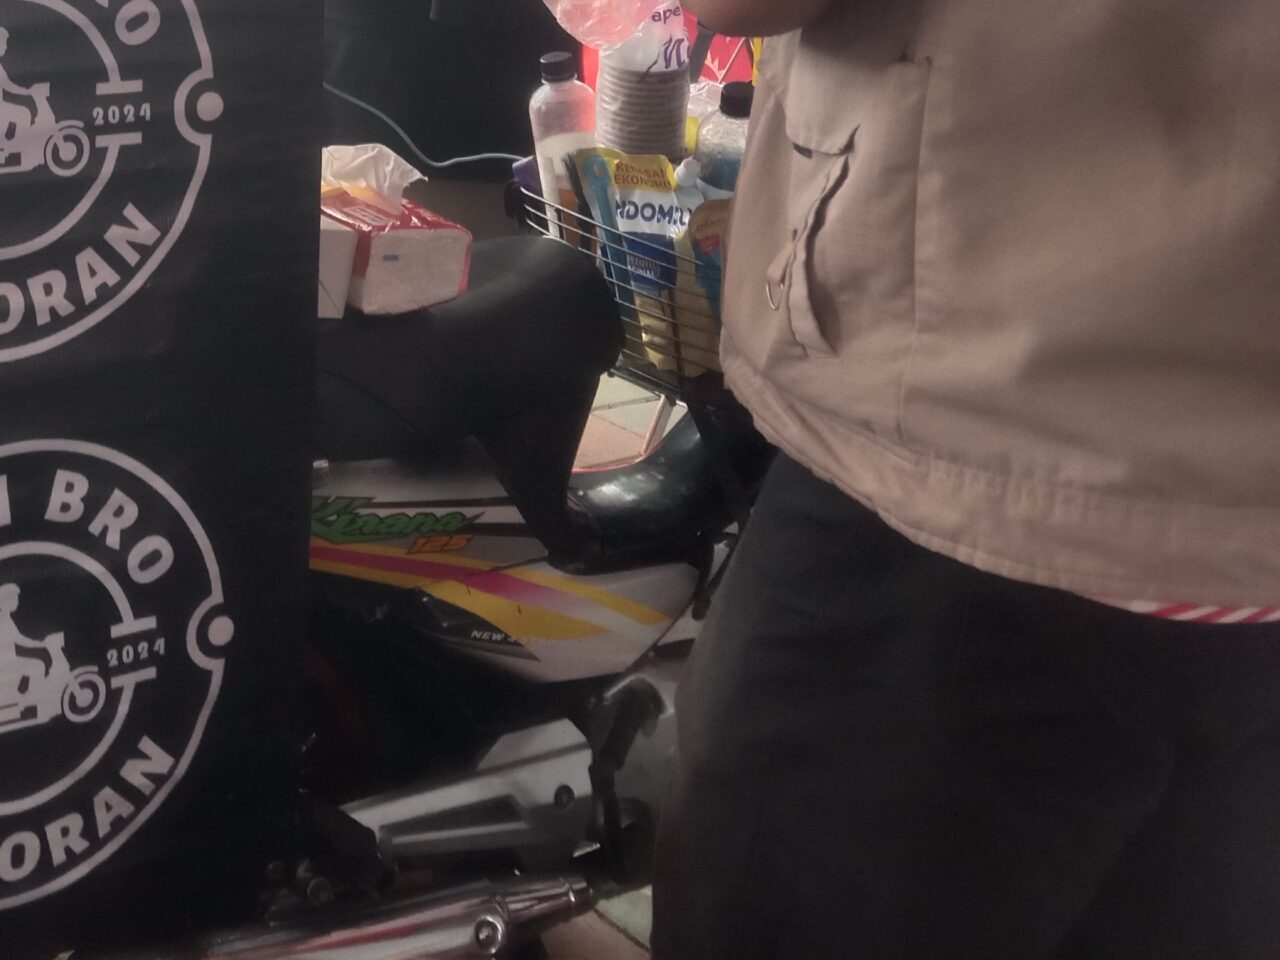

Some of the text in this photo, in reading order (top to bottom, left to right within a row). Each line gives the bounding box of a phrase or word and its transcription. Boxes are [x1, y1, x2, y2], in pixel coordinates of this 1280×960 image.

[91, 102, 153, 126] 2024
[44, 468, 175, 585] BRO
[470, 629, 505, 641] NEW
[106, 637, 166, 668] 2024
